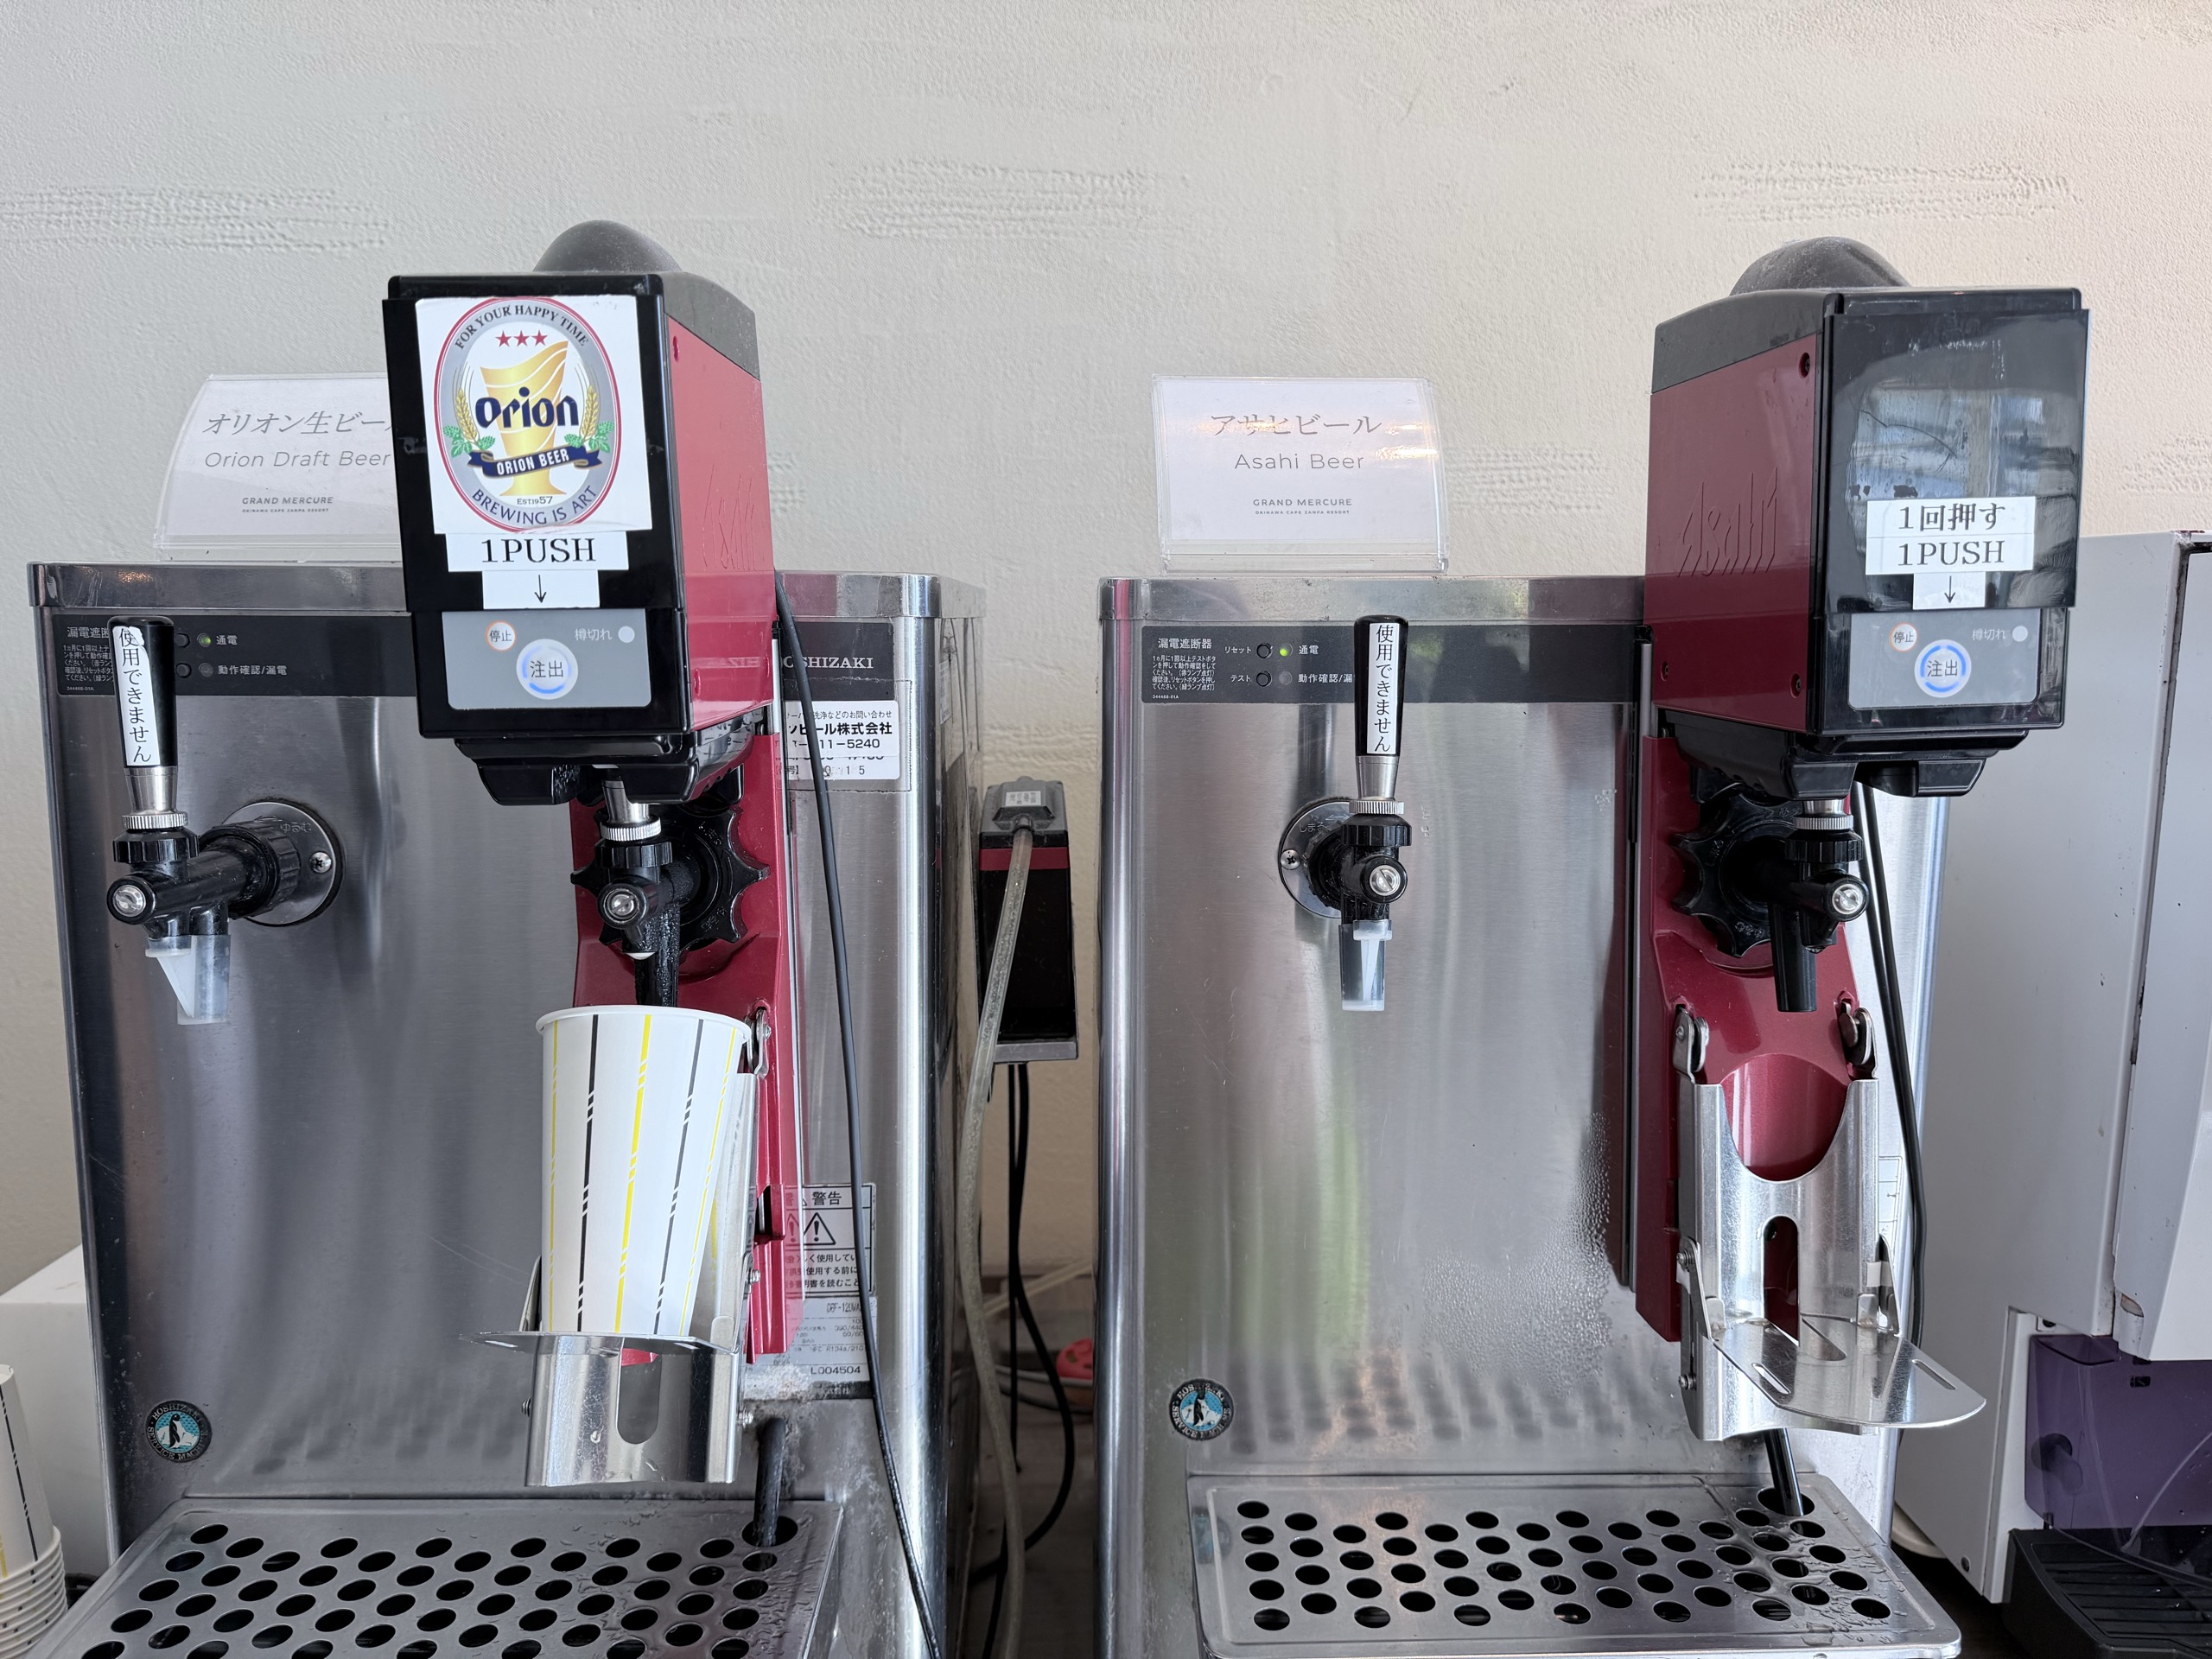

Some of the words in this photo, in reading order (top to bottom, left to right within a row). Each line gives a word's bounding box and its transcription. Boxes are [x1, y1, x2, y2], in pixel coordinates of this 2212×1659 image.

[454, 325, 477, 349] FOR
[475, 307, 512, 327] YOUR
[515, 305, 558, 321] HAPPY
[561, 316, 589, 346] TIME
[1211, 414, 1382, 436] アサヒビール
[205, 452, 264, 467] Orion
[273, 450, 330, 467] Draft
[339, 450, 391, 467] Beer
[497, 459, 535, 475] ORION
[538, 448, 569, 467] BEER
[1235, 454, 1299, 469] Asahi
[1311, 454, 1363, 469] Beer
[472, 489, 547, 524] BREWING
[552, 507, 567, 522] IS
[571, 486, 596, 513] ART
[1898, 503, 2005, 531] 1回押す
[481, 538, 596, 563] 1PUSH
[1898, 540, 2005, 566] 1PUSH
[216, 635, 238, 645] 通電
[489, 630, 512, 643] 停止
[575, 628, 612, 641] 樽切れ
[1893, 632, 1915, 643] 停止
[1972, 628, 2006, 640] 樽切れ
[1158, 638, 1212, 649] 漏電遮断器
[1299, 645, 1319, 655] 通電
[218, 664, 288, 676] 動作確認/漏電
[530, 660, 564, 678] 注出
[1927, 659, 1958, 677] 注出
[119, 628, 151, 764] 使用できません
[1374, 625, 1395, 753] 使用できません
[812, 1191, 842, 1205] 警告
[810, 1366, 861, 1375] L004504
